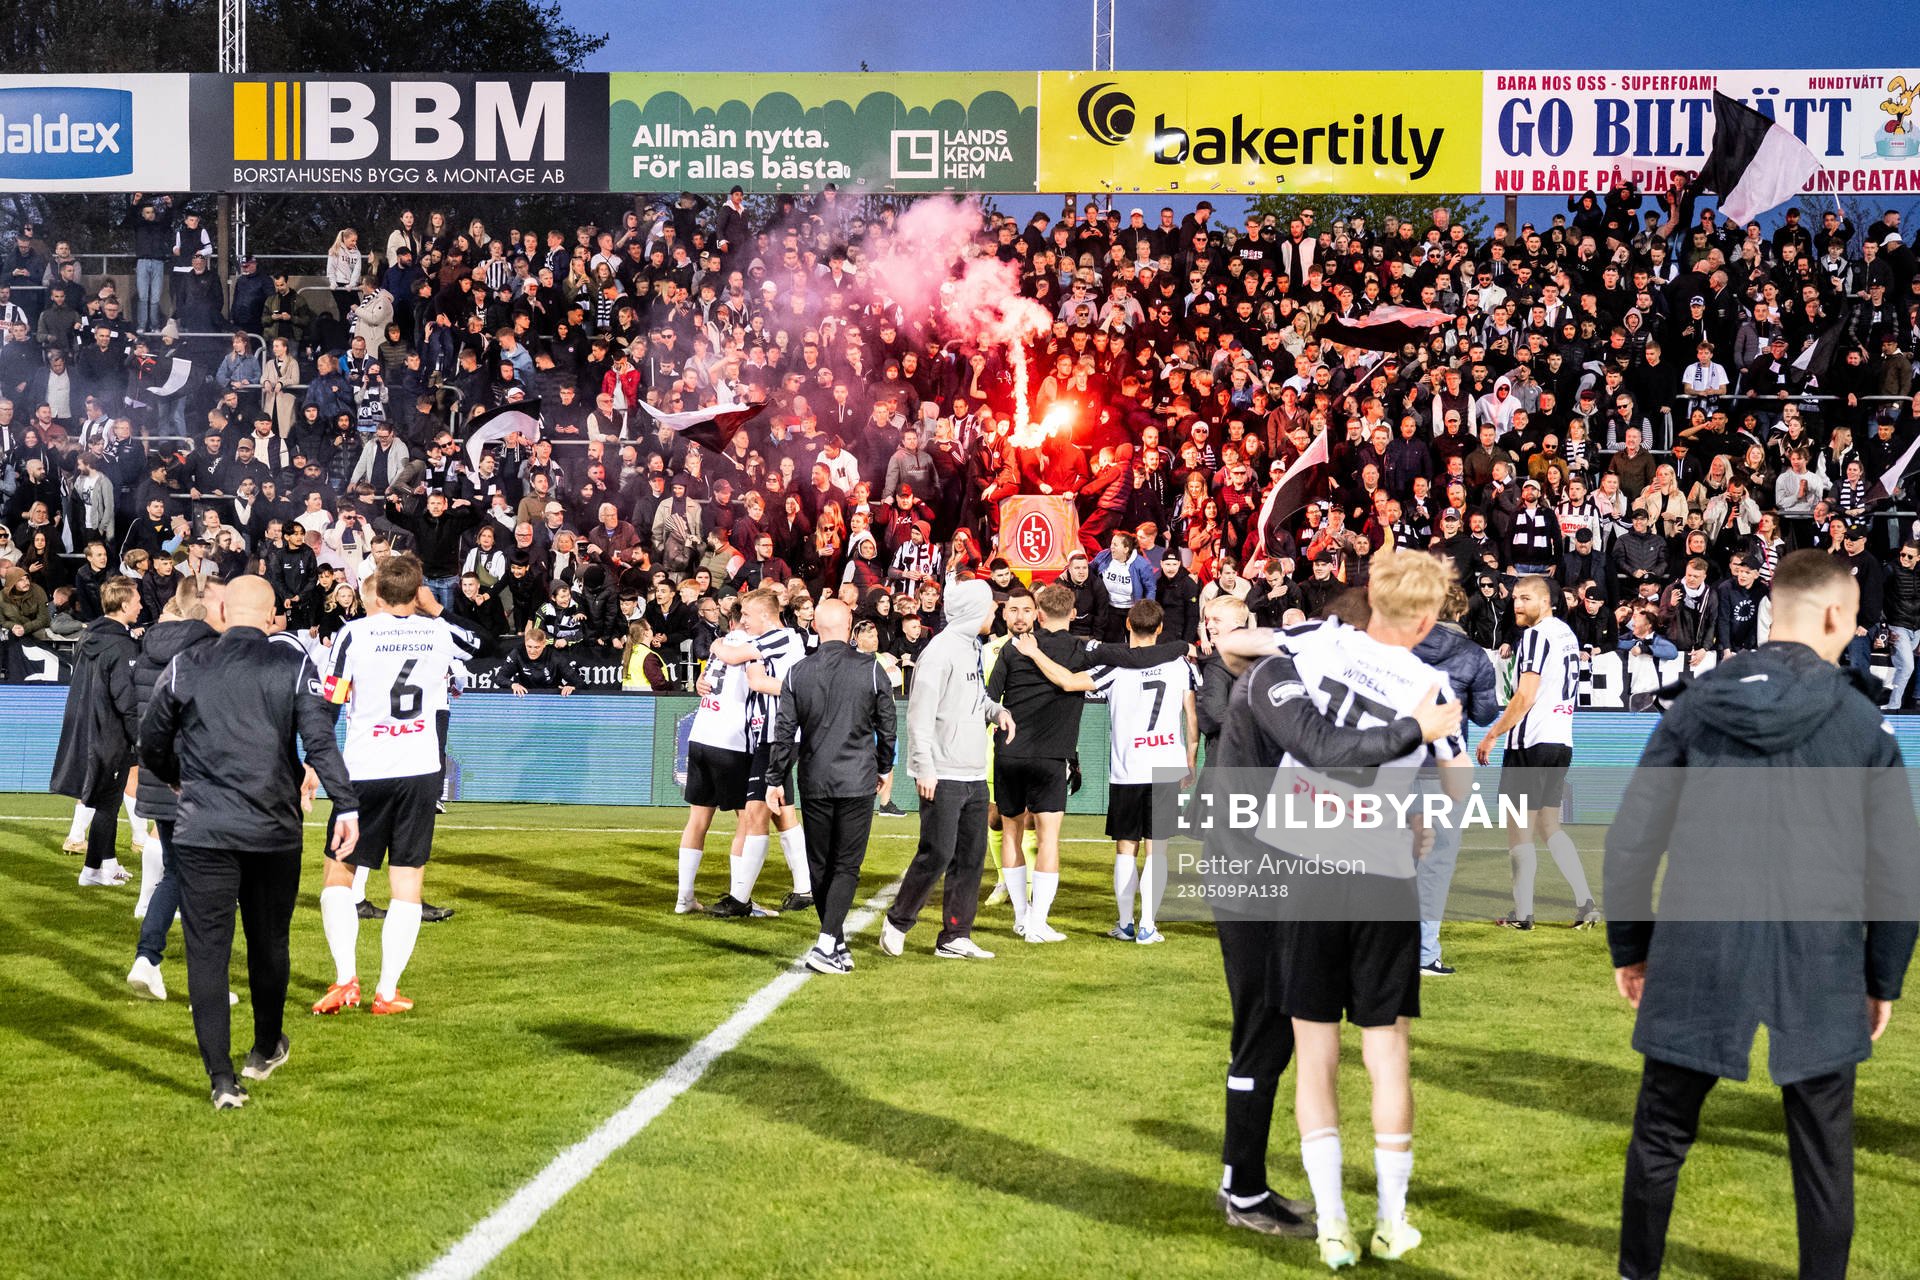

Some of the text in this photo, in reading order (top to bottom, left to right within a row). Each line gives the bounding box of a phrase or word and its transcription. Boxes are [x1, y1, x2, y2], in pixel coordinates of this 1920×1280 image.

[1497, 76, 1536, 90] BARA
[1542, 76, 1571, 90] HOS
[1577, 76, 1606, 90] OSS
[1622, 76, 1717, 90] SUPERFOAM!
[1808, 75, 1884, 89] HUNDTVÄTT
[0, 113, 120, 154] aldex
[305, 81, 566, 161] BBM
[1498, 97, 1573, 157] GO
[632, 123, 830, 154] Allmän nytta.
[944, 129, 1008, 145] LANDS
[1153, 113, 1445, 180] bakertilly
[633, 154, 681, 178] För
[687, 154, 755, 179] allas
[944, 146, 1014, 162] KRONA
[233, 168, 565, 183] BORSTAHUSENS BYGG & MONTAGE AB
[944, 163, 985, 178] HEM
[1495, 169, 1524, 191] NU
[1532, 165, 1588, 191] BÅDE
[1597, 165, 1624, 191] PÅ
[375, 644, 433, 652] ANDERSSON
[390, 659, 423, 720] 6
[1343, 669, 1387, 698] WIDELL
[1142, 680, 1166, 732] 7
[373, 720, 425, 737] PULS
[1134, 733, 1175, 749] PULS
